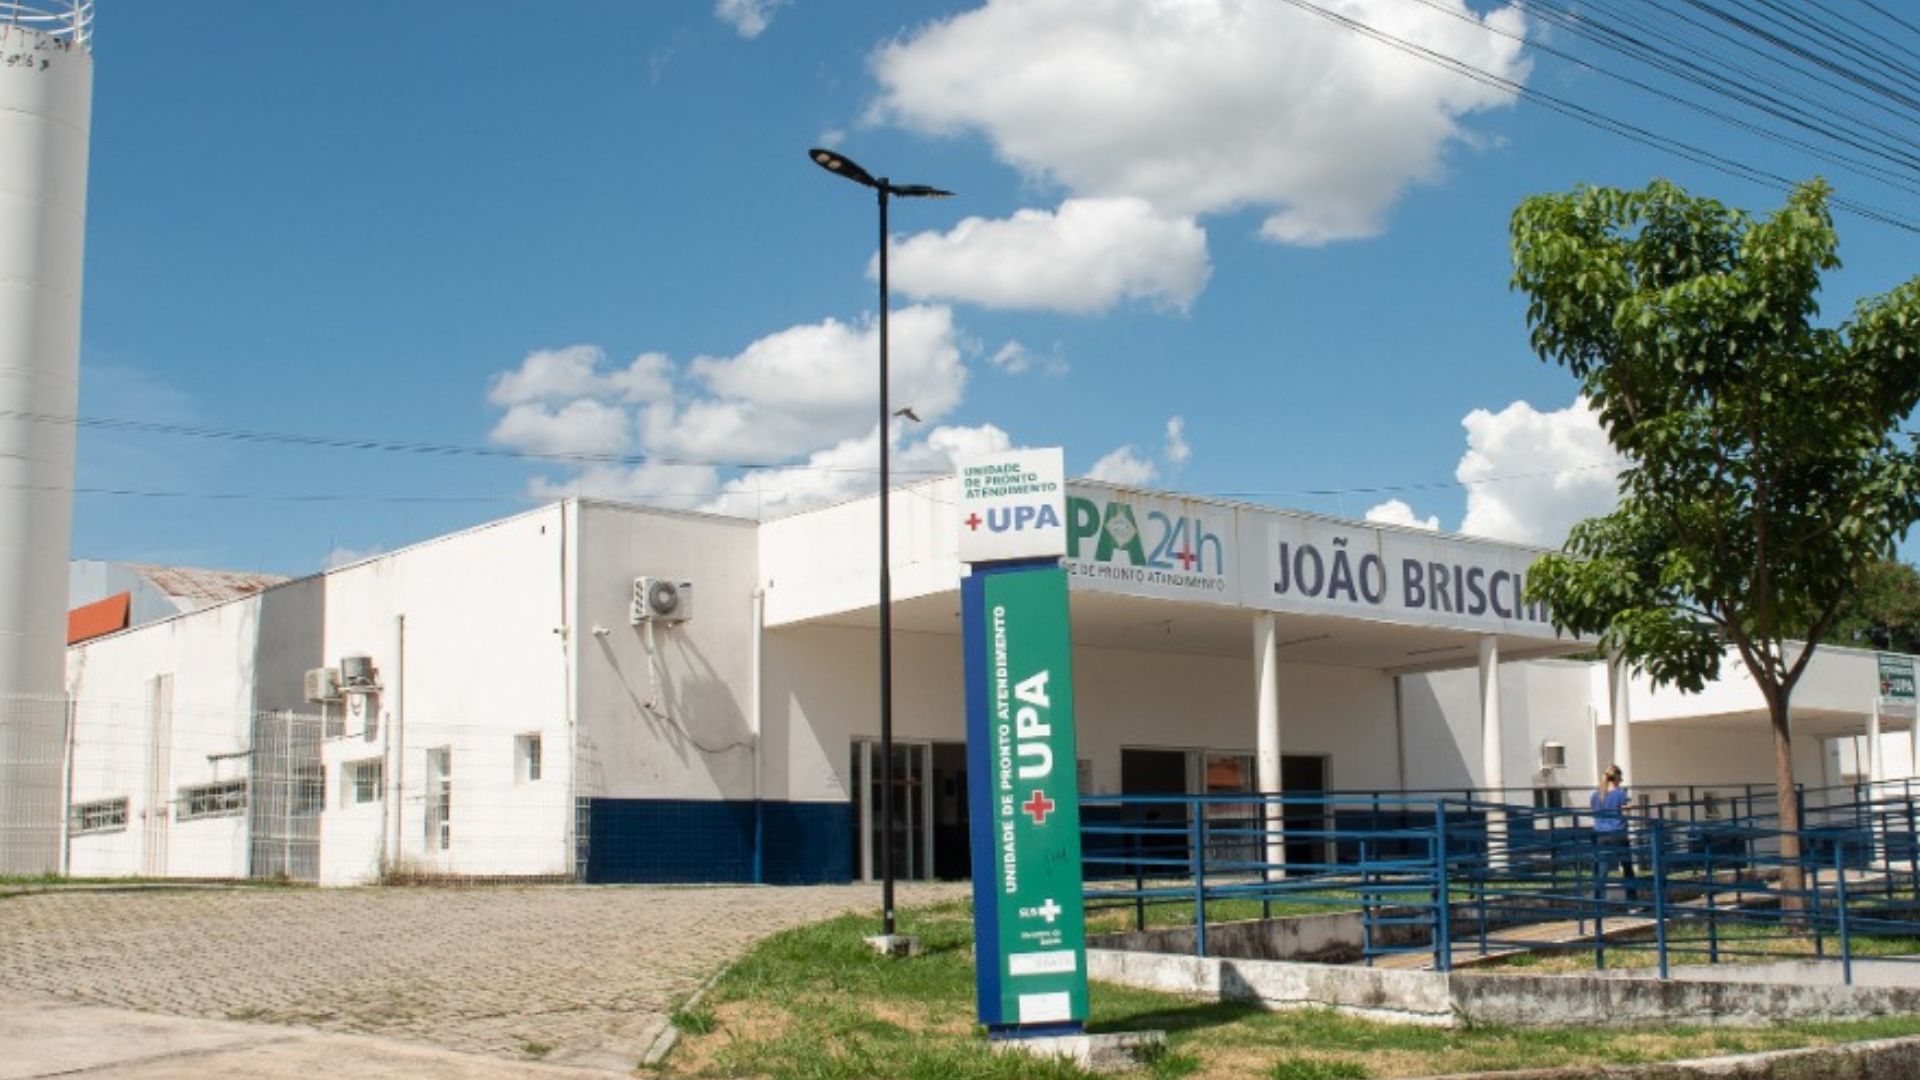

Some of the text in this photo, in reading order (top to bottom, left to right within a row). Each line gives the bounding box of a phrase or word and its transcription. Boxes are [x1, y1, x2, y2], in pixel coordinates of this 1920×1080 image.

[964, 464, 1020, 476] UNIDADE
[965, 473, 1037, 488] DE PRONTO
[966, 482, 1057, 498] ATENDIMENTO
[987, 504, 1060, 533] UPA
[1065, 495, 1223, 575] PA 24h
[1098, 567, 1144, 582] PRONTO
[1274, 537, 1387, 605] JOÃO
[1014, 669, 1053, 778] UPA
[993, 606, 1017, 893] UNIDADE DE PRONTO ATENDIMENTO
